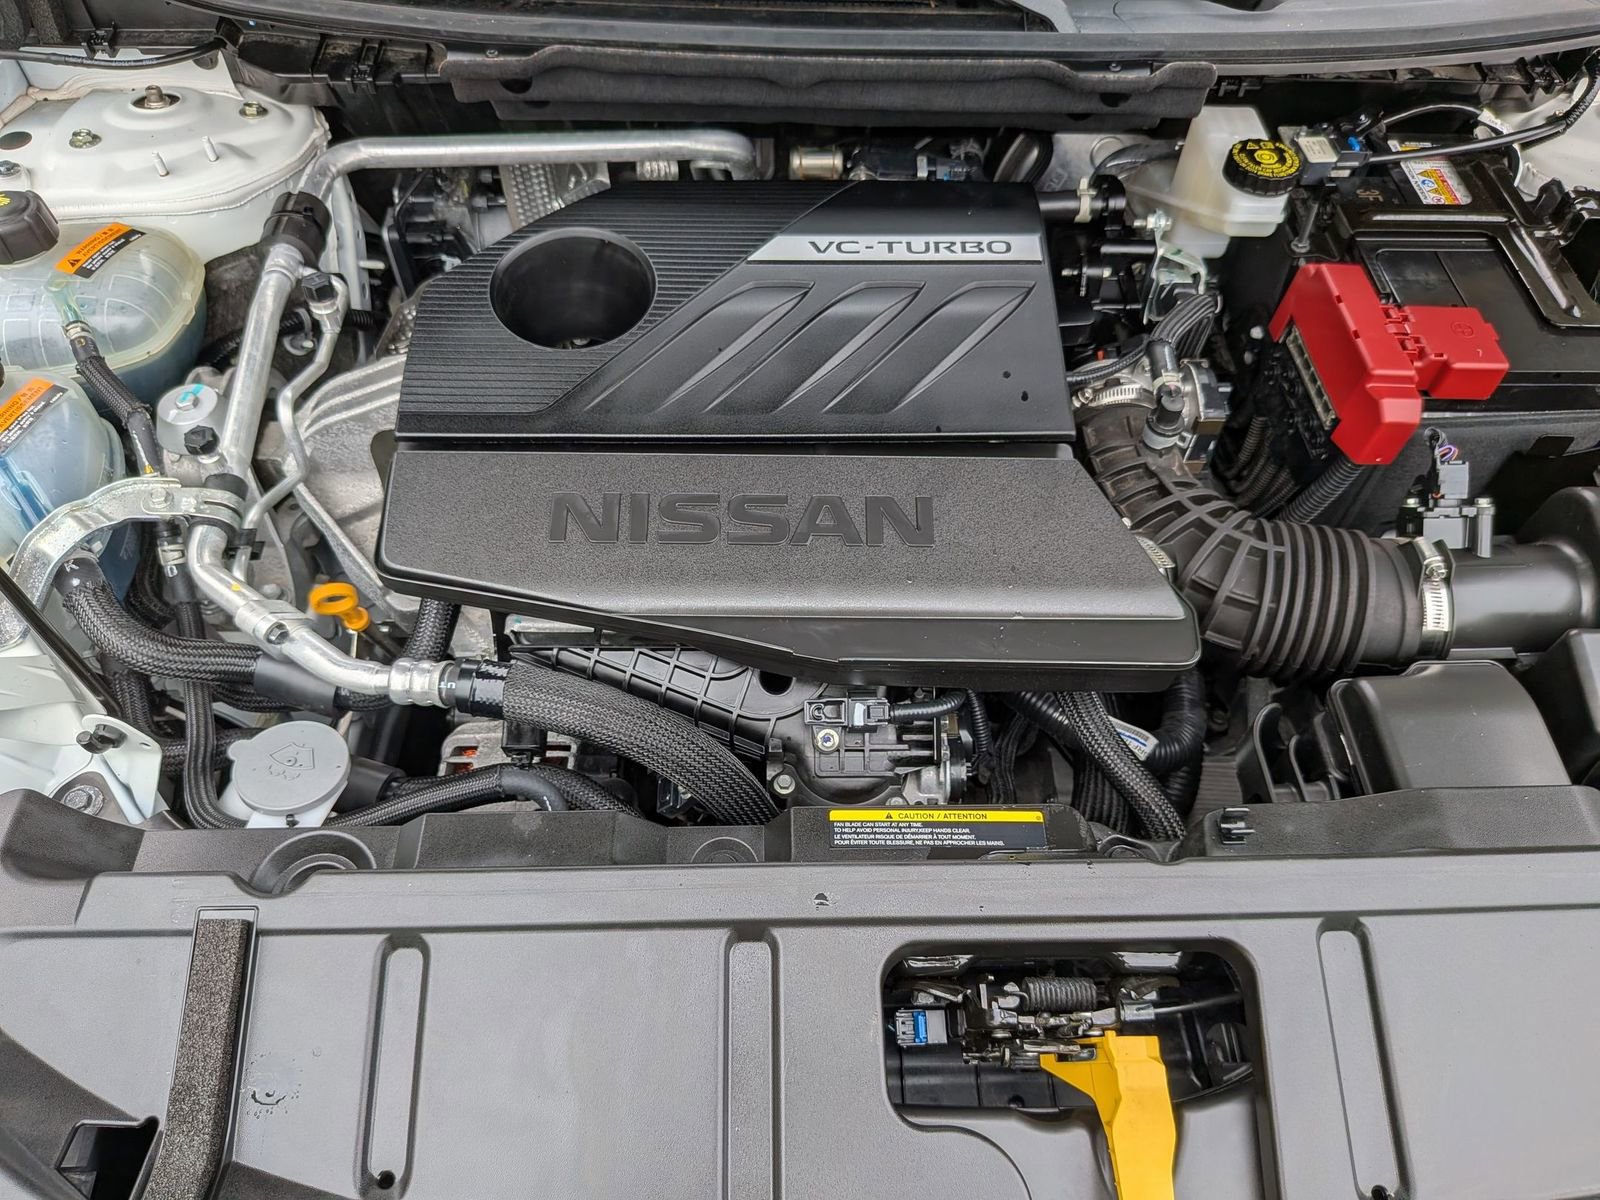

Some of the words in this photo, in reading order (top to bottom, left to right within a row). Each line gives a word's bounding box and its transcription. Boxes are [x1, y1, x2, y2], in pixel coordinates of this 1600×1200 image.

[808, 240, 1012, 255] VC-TURBO
[548, 491, 934, 548] NISSAN
[898, 812, 934, 820] CAUTION
[943, 812, 987, 820] ATTENTION
